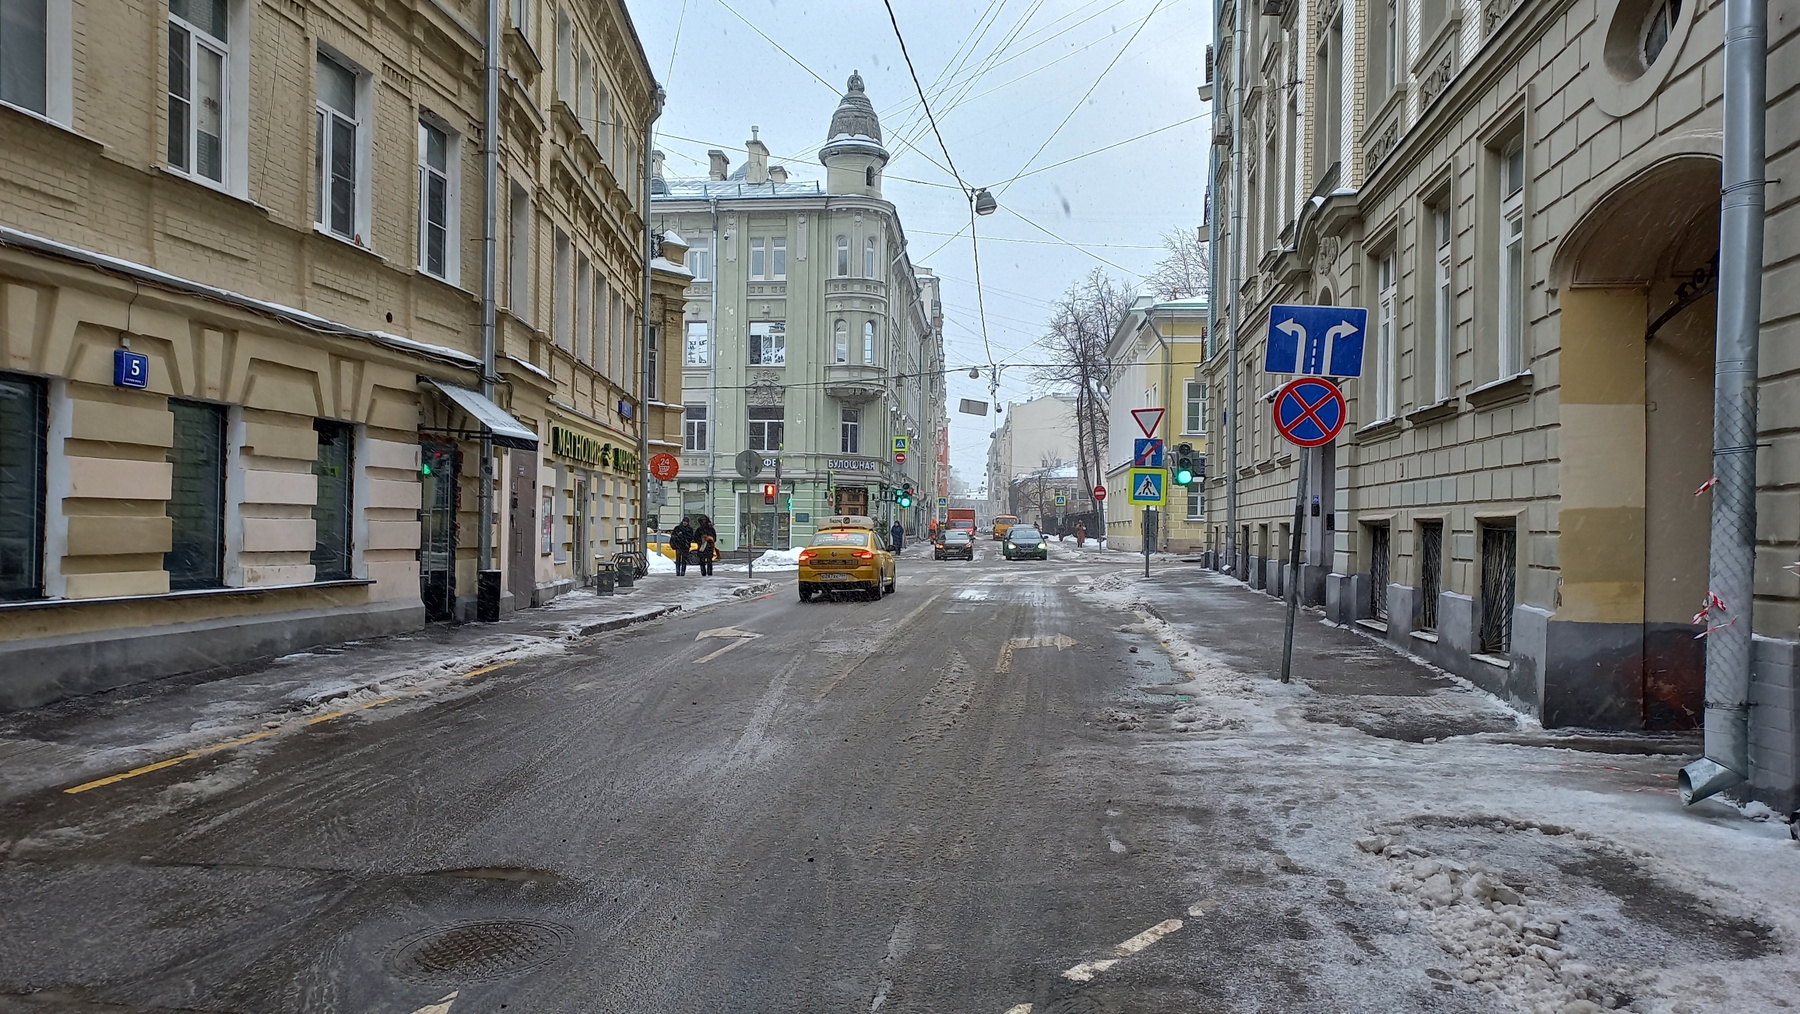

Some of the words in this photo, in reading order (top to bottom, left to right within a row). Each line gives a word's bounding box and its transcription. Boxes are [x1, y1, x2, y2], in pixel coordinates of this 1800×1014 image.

[131, 359, 140, 376] 5
[555, 427, 602, 466] МАГНОЛИЯ
[660, 458, 670, 466] 24
